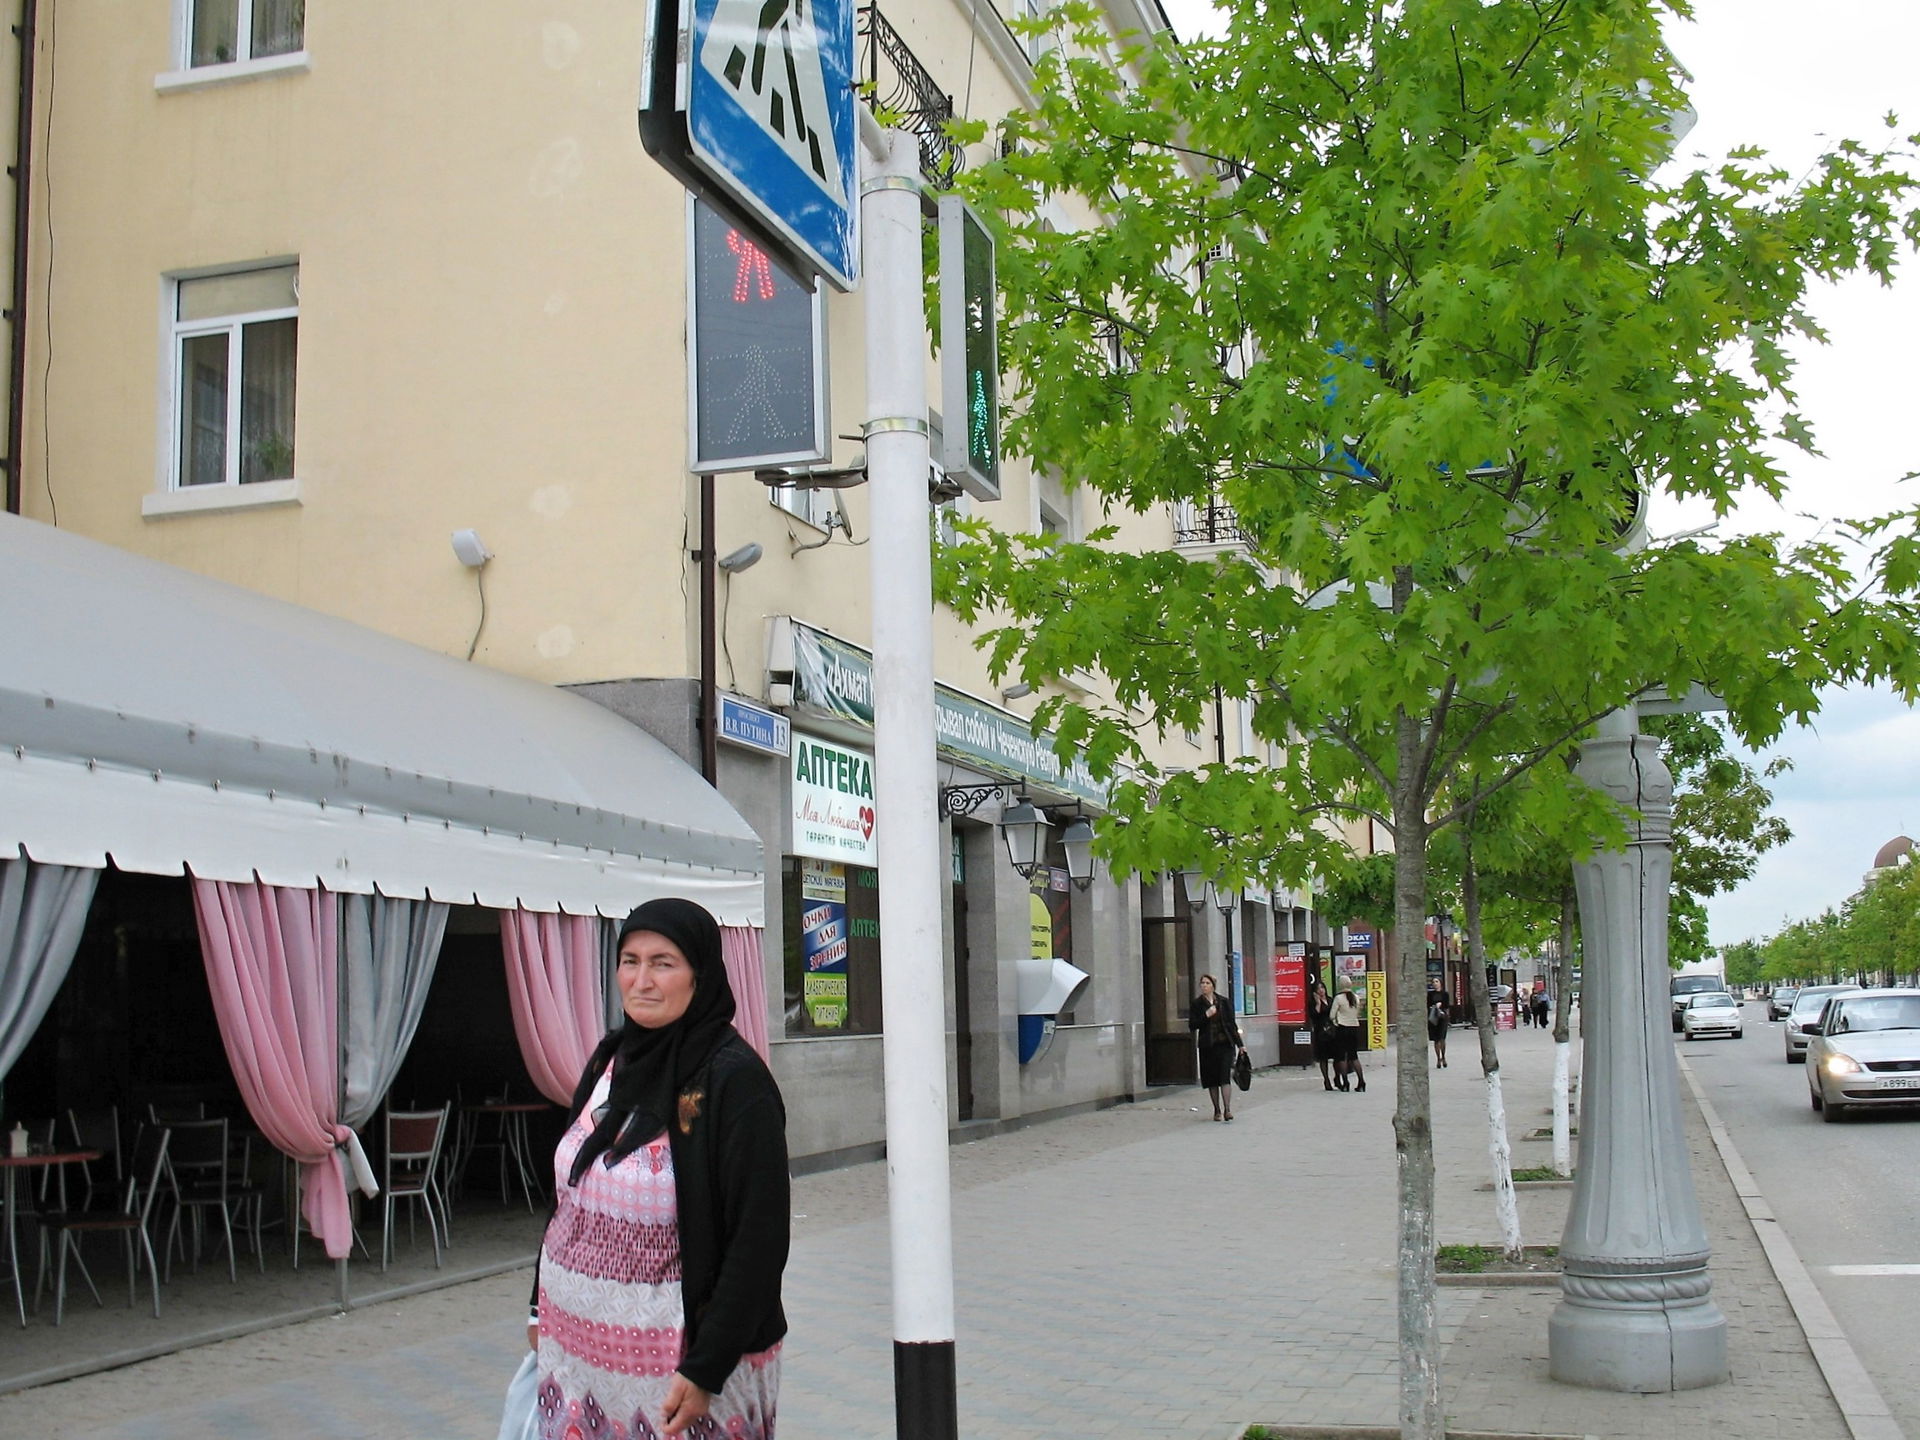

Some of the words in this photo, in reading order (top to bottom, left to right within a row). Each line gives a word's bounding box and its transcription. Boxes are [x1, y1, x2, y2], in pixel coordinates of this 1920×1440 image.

[740, 721, 772, 744] ПУТИНА
[776, 724, 786, 746] 13
[935, 703, 965, 741] рывал
[965, 711, 990, 749] собой
[990, 726, 996, 752] и
[796, 741, 873, 800] АПТЕКА
[796, 794, 818, 822] Моя
[820, 800, 860, 831] Любимая
[806, 831, 836, 846] ГАРАНТИЯ
[839, 837, 866, 851] КАЧЕСТВА
[857, 870, 877, 888] МОЯ
[803, 905, 832, 929] ОЧКИ
[850, 918, 880, 938] АПТЕК
[818, 924, 837, 944] ДЛЯ
[809, 941, 847, 971] ЗРЕНИЯ
[1371, 981, 1382, 1044] DOLORES
